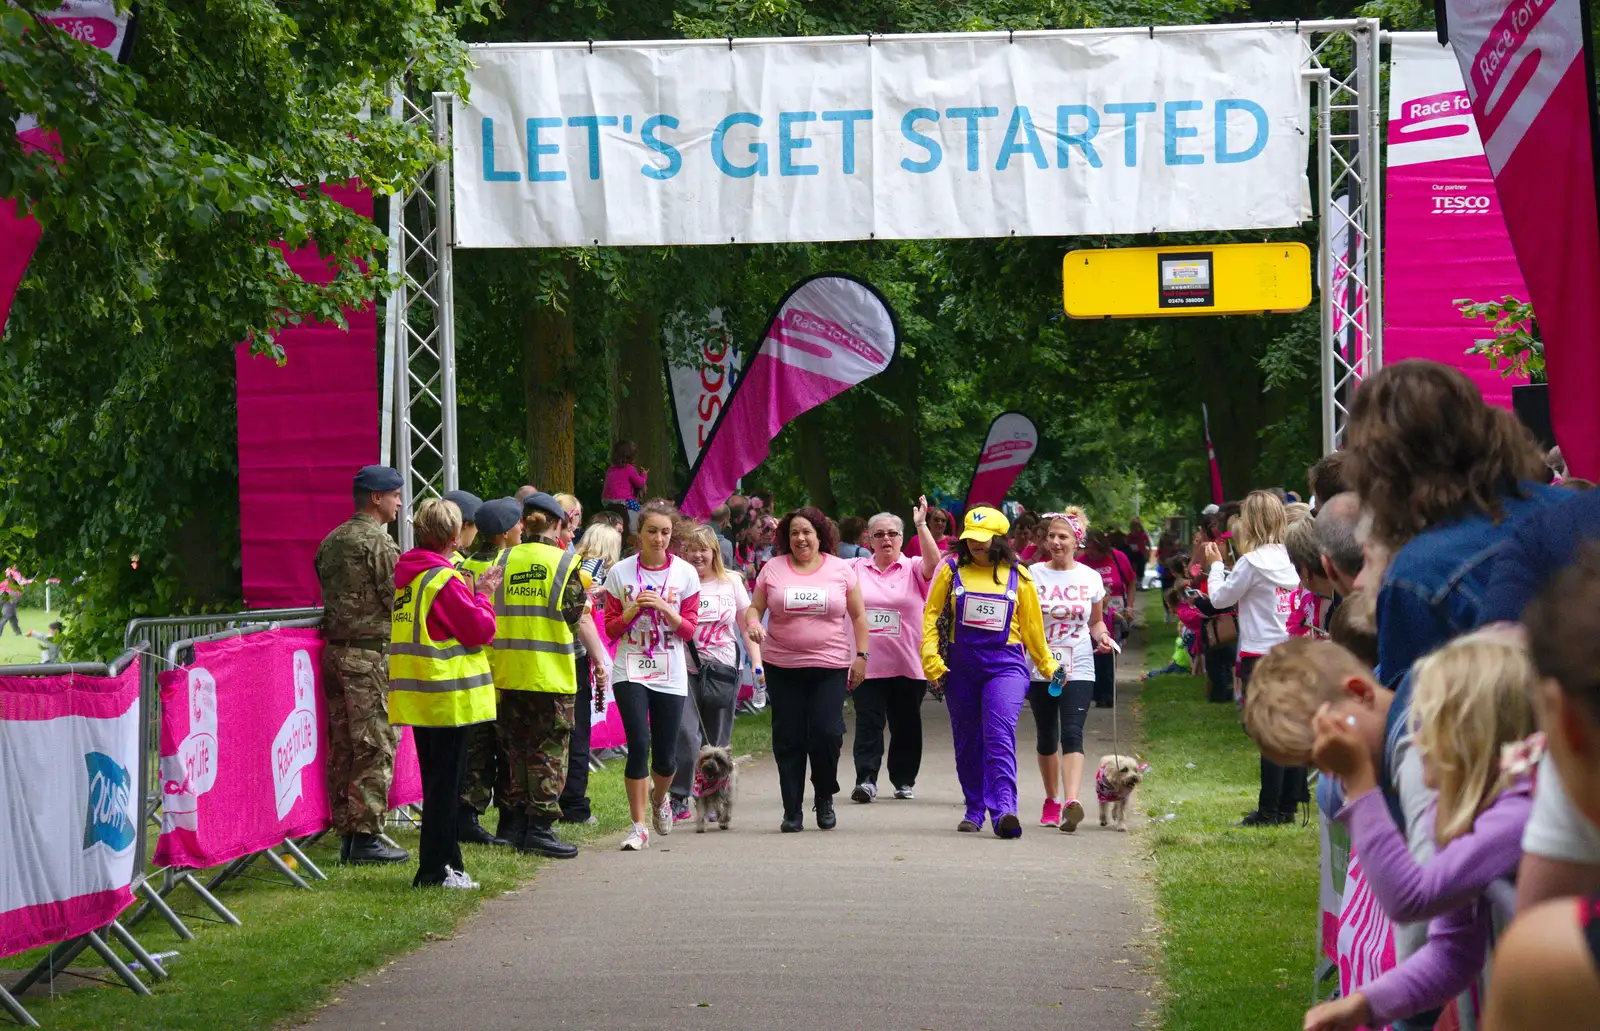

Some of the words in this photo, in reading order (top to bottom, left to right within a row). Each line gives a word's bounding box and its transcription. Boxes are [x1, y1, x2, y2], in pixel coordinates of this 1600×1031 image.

[1480, 29, 1515, 86] Race
[1512, 0, 1534, 34] for
[1410, 100, 1450, 119] Race
[1453, 95, 1472, 110] fo
[481, 113, 682, 182] LET'S
[710, 109, 874, 179] GET
[900, 98, 1270, 174] STARTED
[1444, 184, 1467, 192] partner
[1431, 196, 1490, 209] TESCO
[791, 313, 826, 333] Race
[506, 586, 547, 599] MARSHAL
[794, 592, 818, 601] 1022
[976, 605, 995, 615] 453
[874, 615, 890, 623] 170
[1047, 624, 1083, 644] IFE
[638, 660, 657, 669] 201
[277, 736, 293, 784] Race
